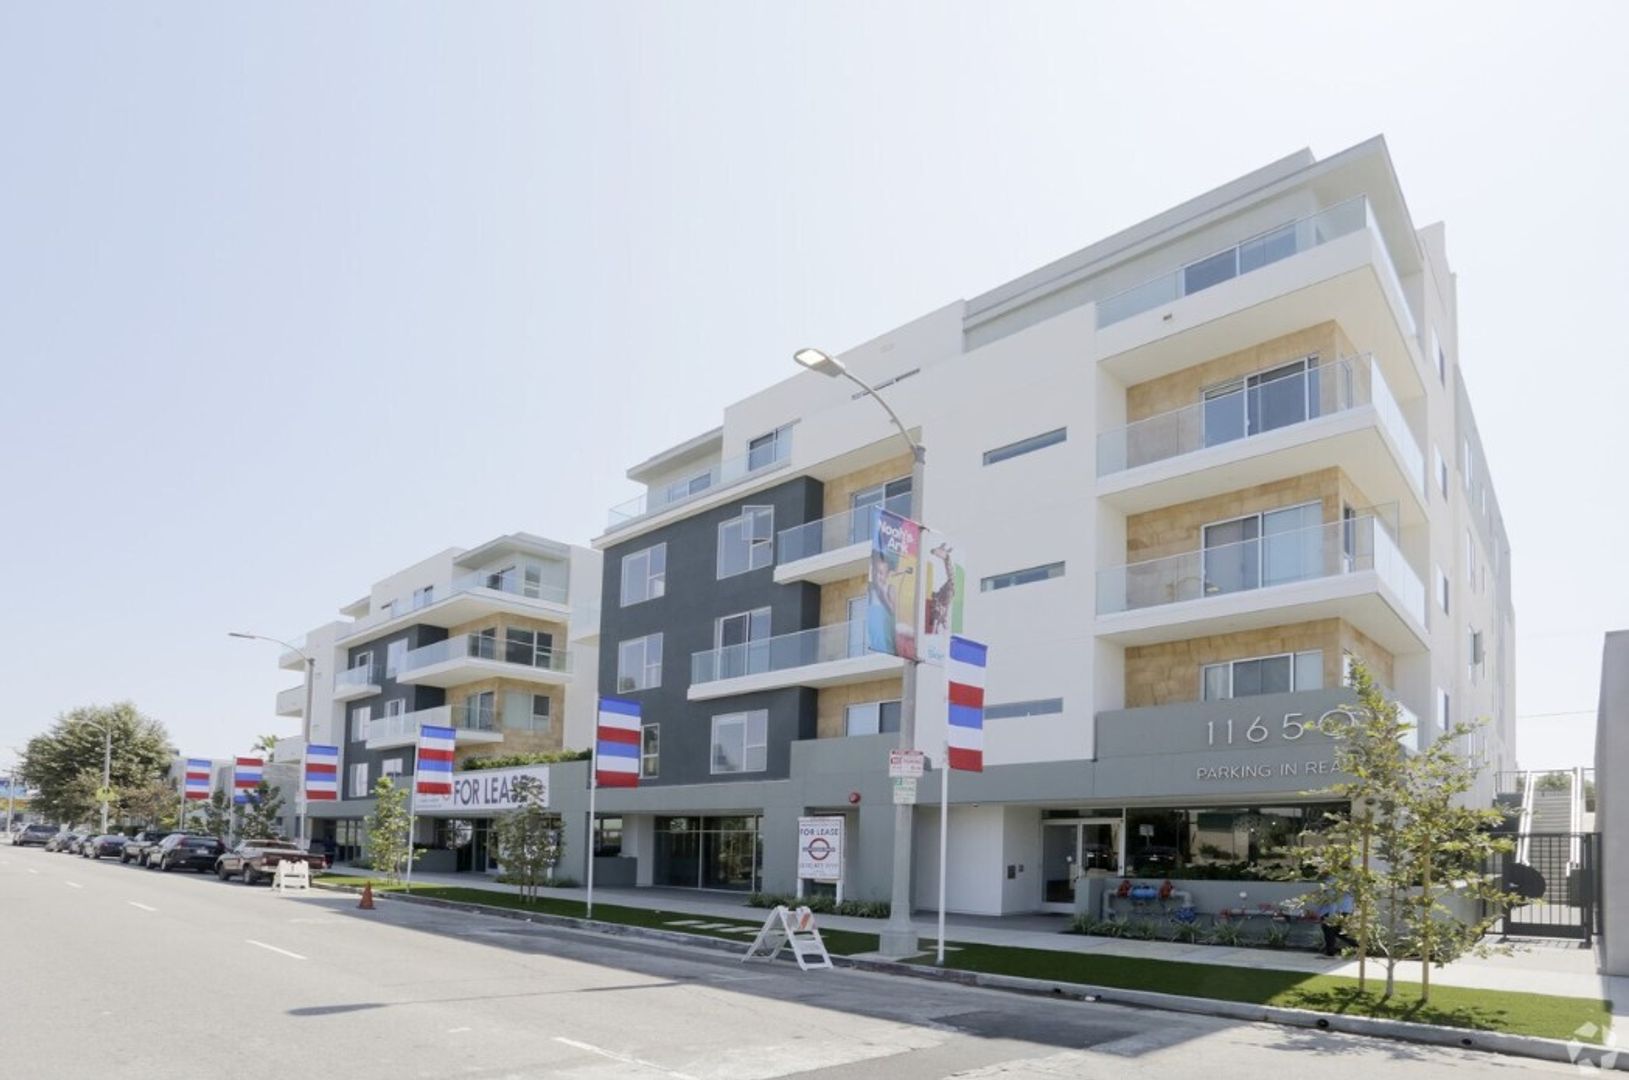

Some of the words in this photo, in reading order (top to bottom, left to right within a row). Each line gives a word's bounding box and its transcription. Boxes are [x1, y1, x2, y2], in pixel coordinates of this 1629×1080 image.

[886, 536, 909, 553] Ark
[1207, 709, 1355, 745] 11650
[1196, 764, 1271, 780] PARKING
[1280, 763, 1297, 776] IN
[1305, 760, 1342, 774] REA
[453, 779, 480, 805] FOR
[800, 828, 814, 836] FOR
[817, 828, 839, 836] LEASE
